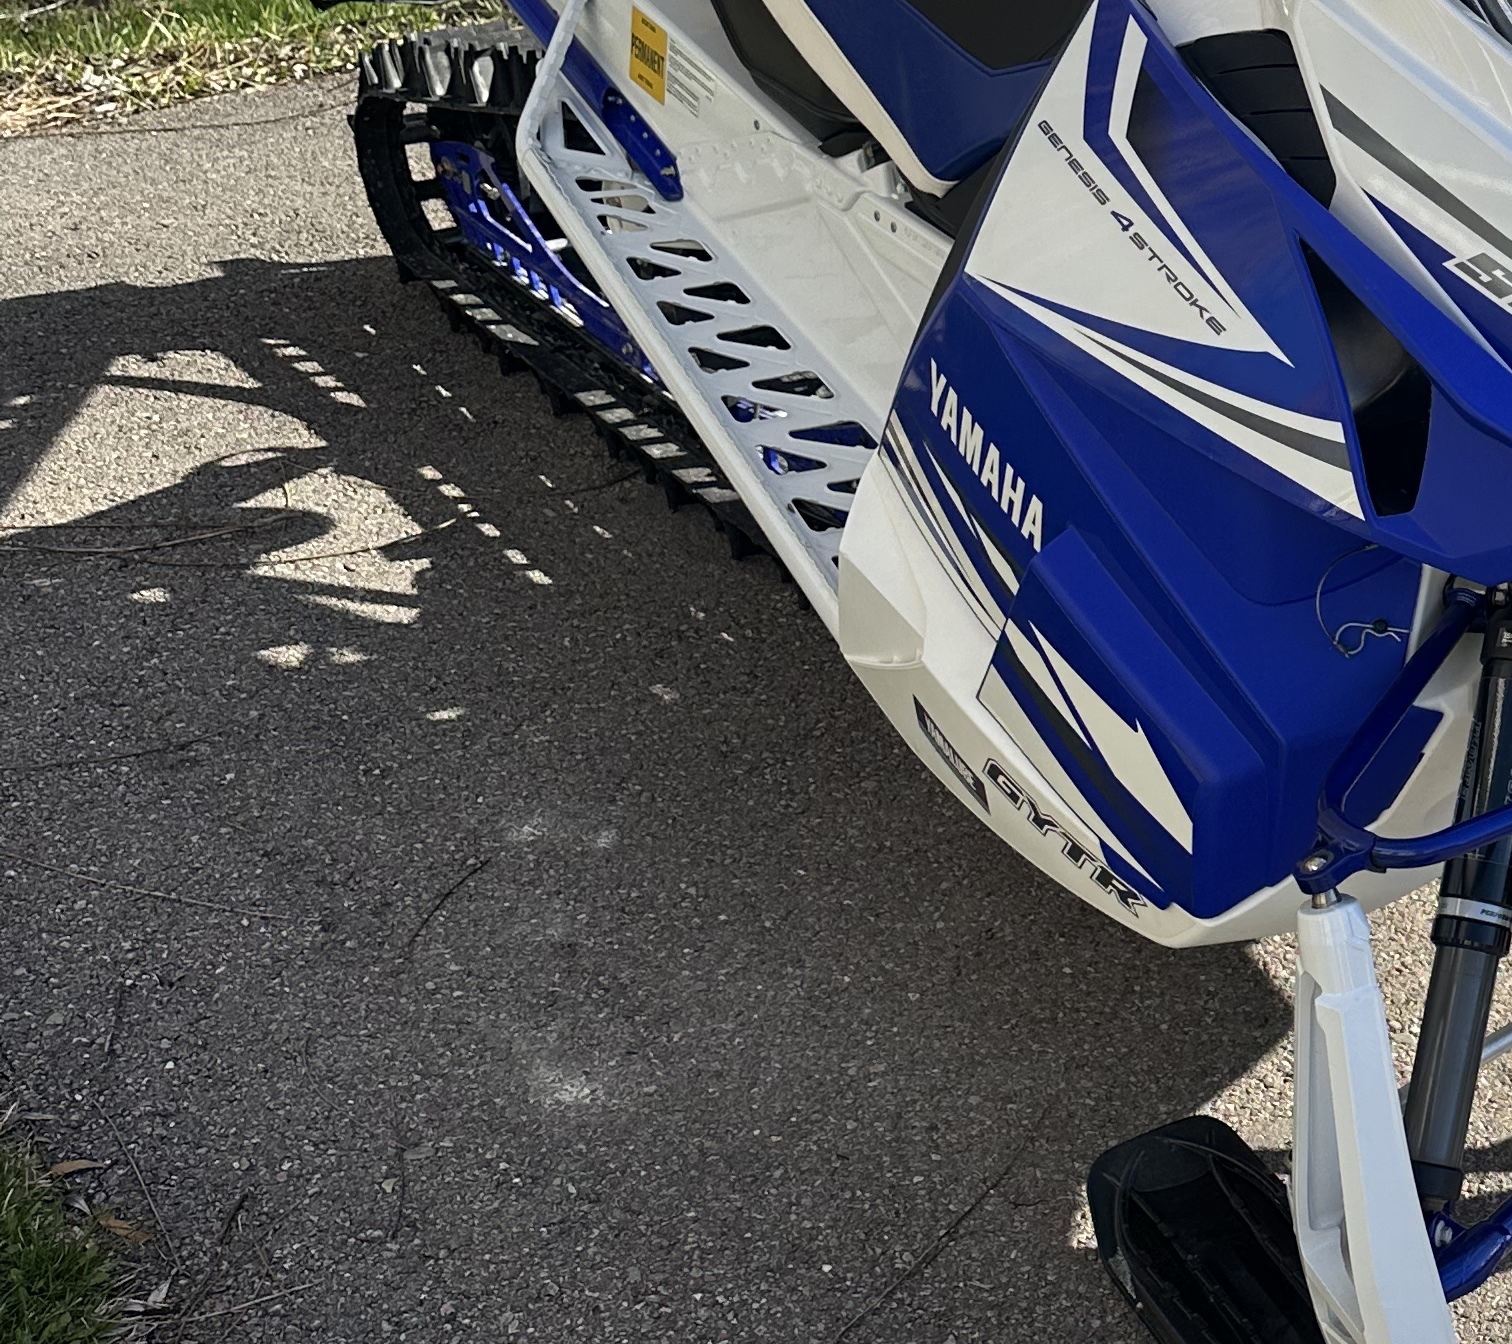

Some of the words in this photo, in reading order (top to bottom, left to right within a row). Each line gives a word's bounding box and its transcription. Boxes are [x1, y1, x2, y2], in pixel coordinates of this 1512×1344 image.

[631, 32, 664, 79] PERMANENT
[1038, 120, 1110, 206] GENESIS
[930, 357, 1043, 553] YAMAHA
[982, 757, 1148, 919] GYTR
